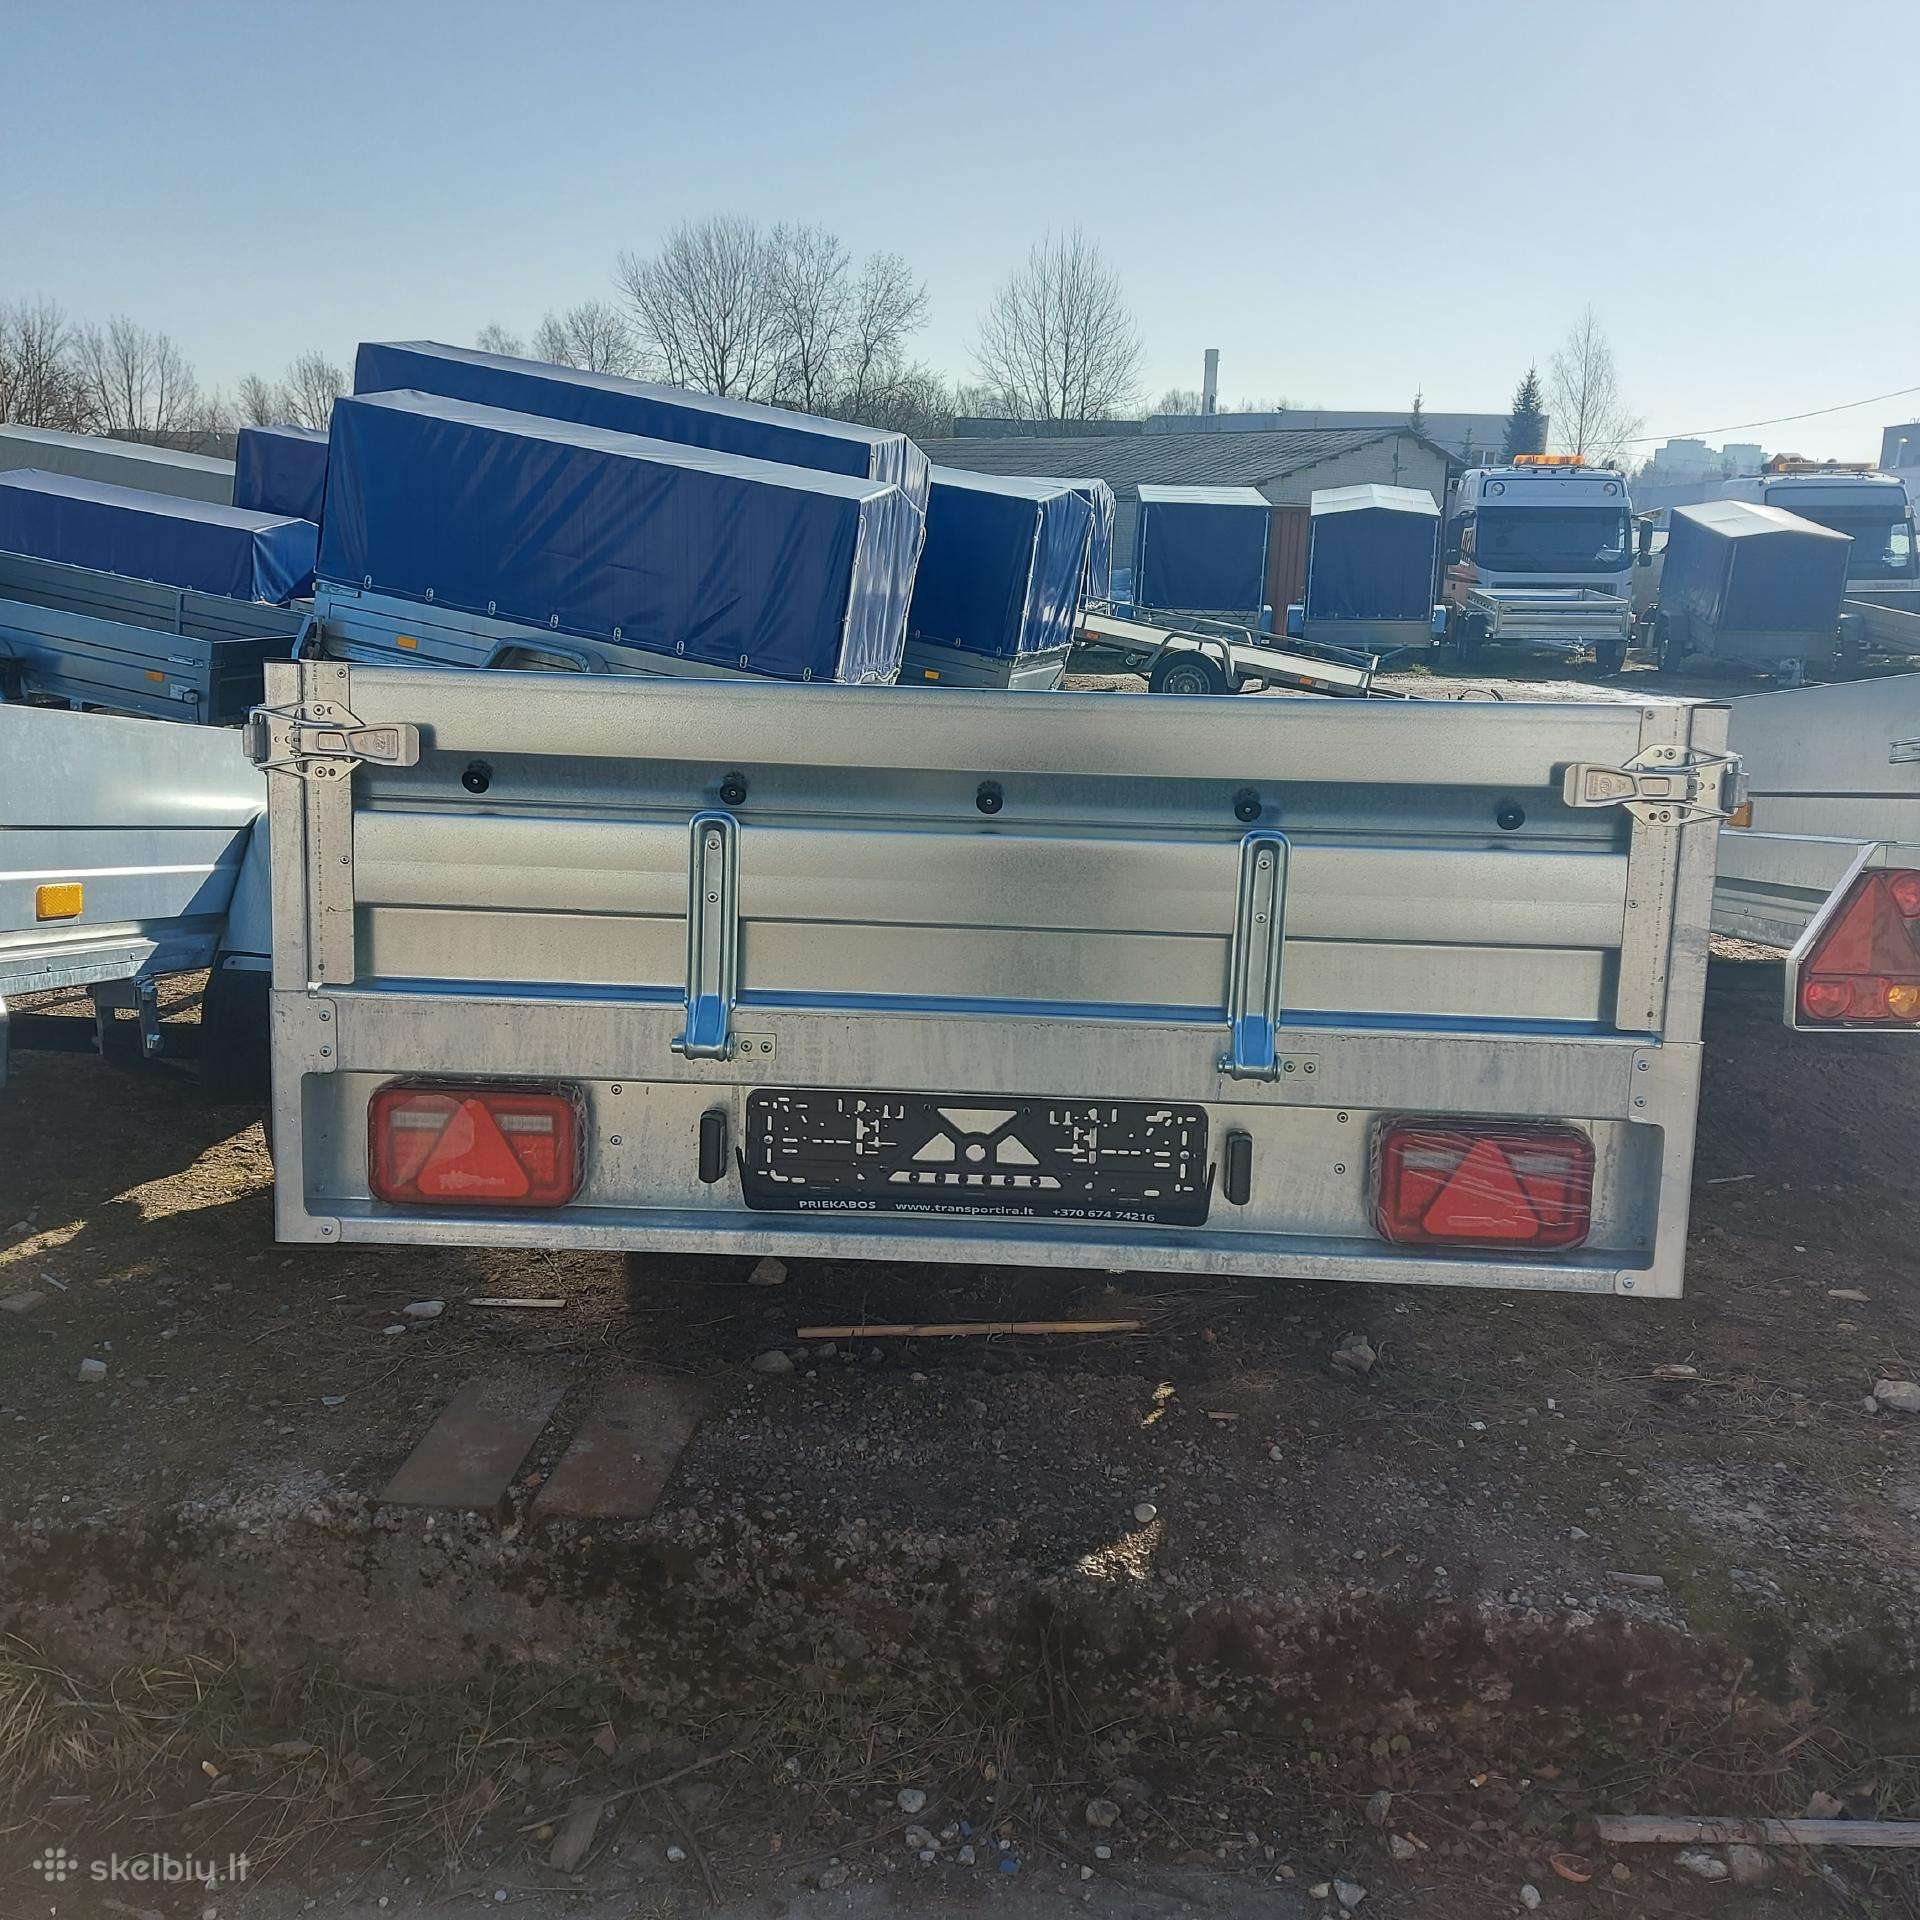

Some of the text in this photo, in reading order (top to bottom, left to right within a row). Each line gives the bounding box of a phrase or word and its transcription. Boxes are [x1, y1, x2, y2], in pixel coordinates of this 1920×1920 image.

[799, 1200, 1156, 1222] PRIEKABOS www.transportira.lt +370 674 74216
